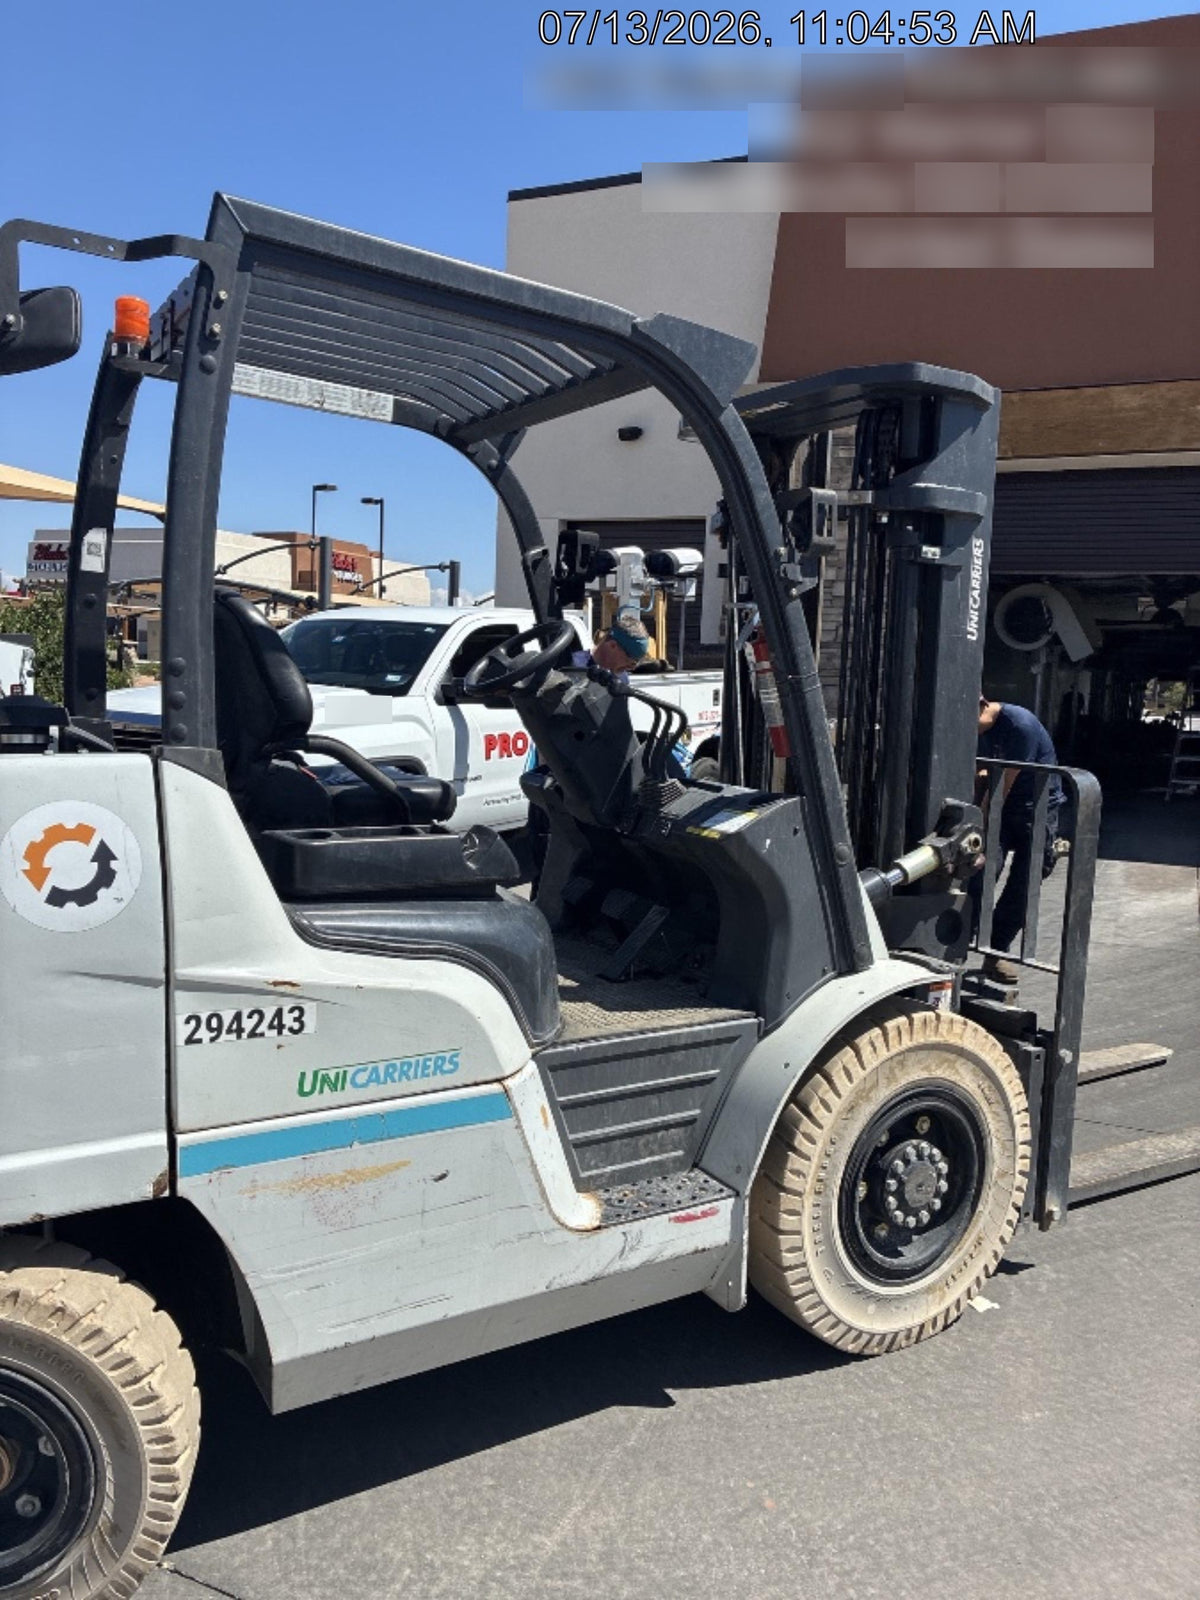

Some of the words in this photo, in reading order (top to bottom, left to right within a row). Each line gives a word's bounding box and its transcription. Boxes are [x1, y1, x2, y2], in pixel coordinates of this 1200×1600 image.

[966, 537, 985, 641] UNICARRIERS
[484, 731, 528, 761] PRO
[184, 1005, 306, 1045] 294243
[297, 1051, 460, 1098] UNICARRIERS
